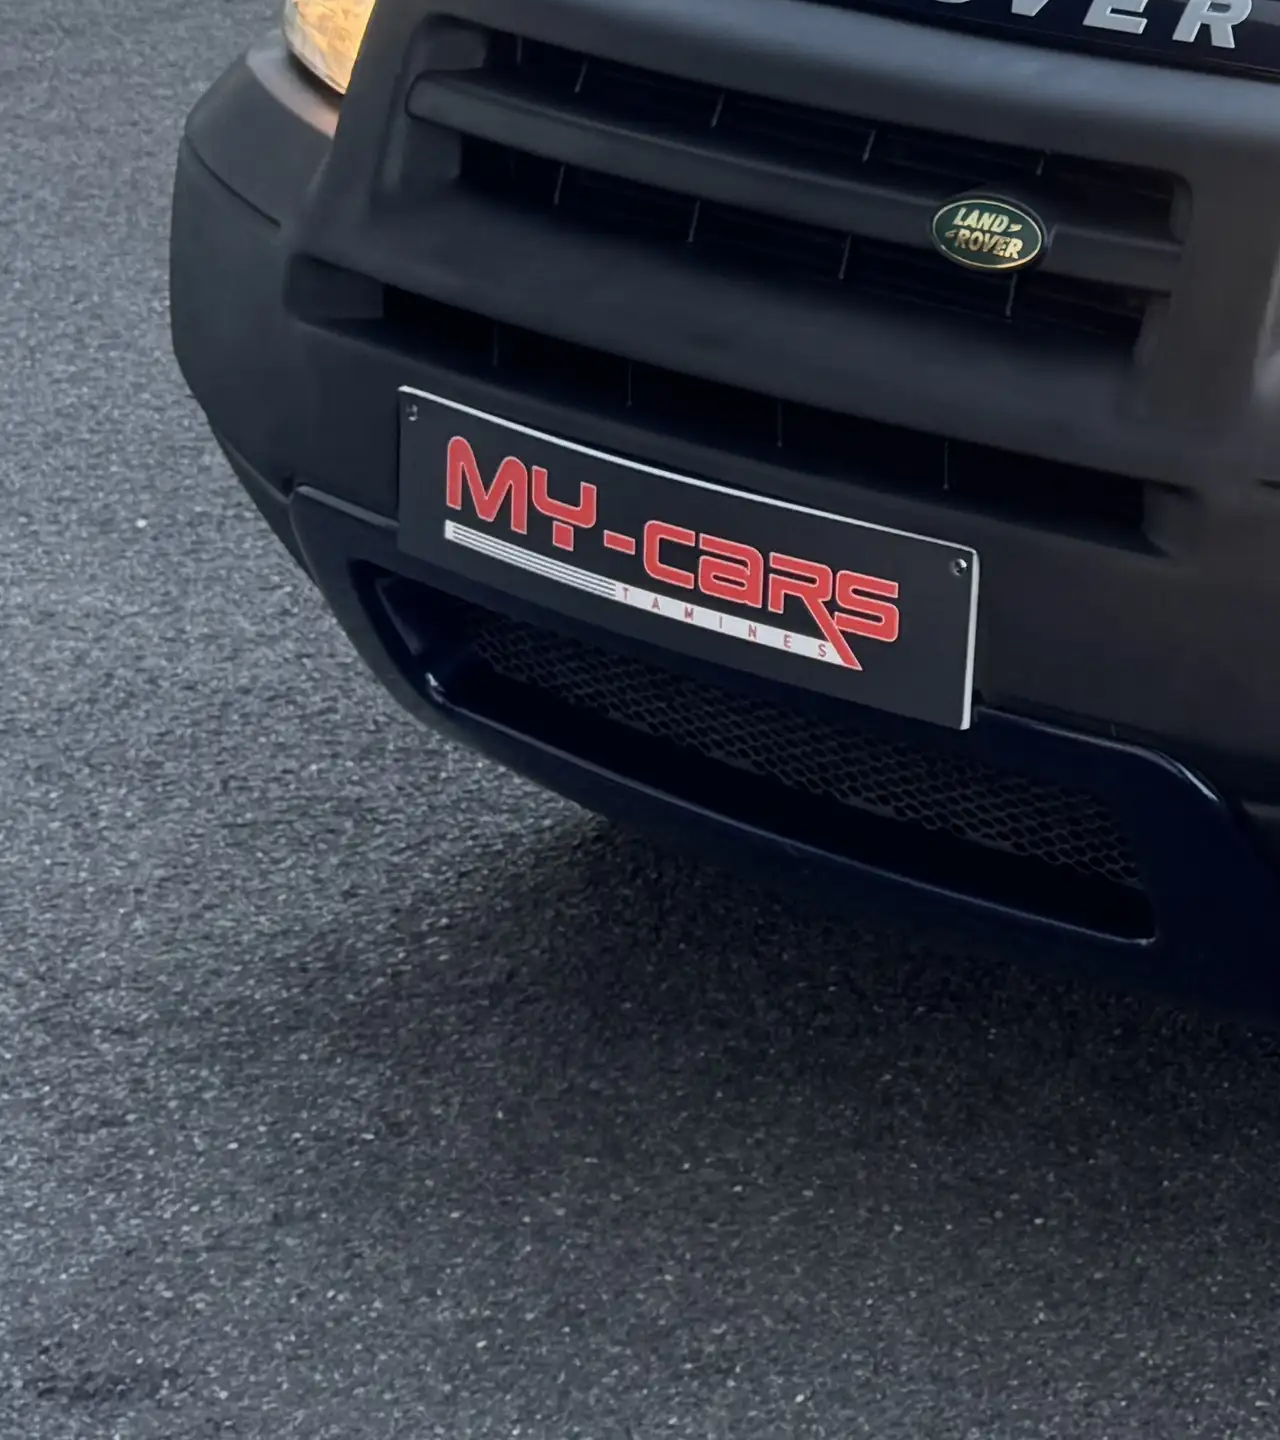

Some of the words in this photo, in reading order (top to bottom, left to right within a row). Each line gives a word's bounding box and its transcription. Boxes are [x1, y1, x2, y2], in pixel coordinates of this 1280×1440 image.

[952, 207, 1010, 233] LAND
[954, 228, 1024, 259] ROVER
[620, 586, 829, 658] TAMINES
